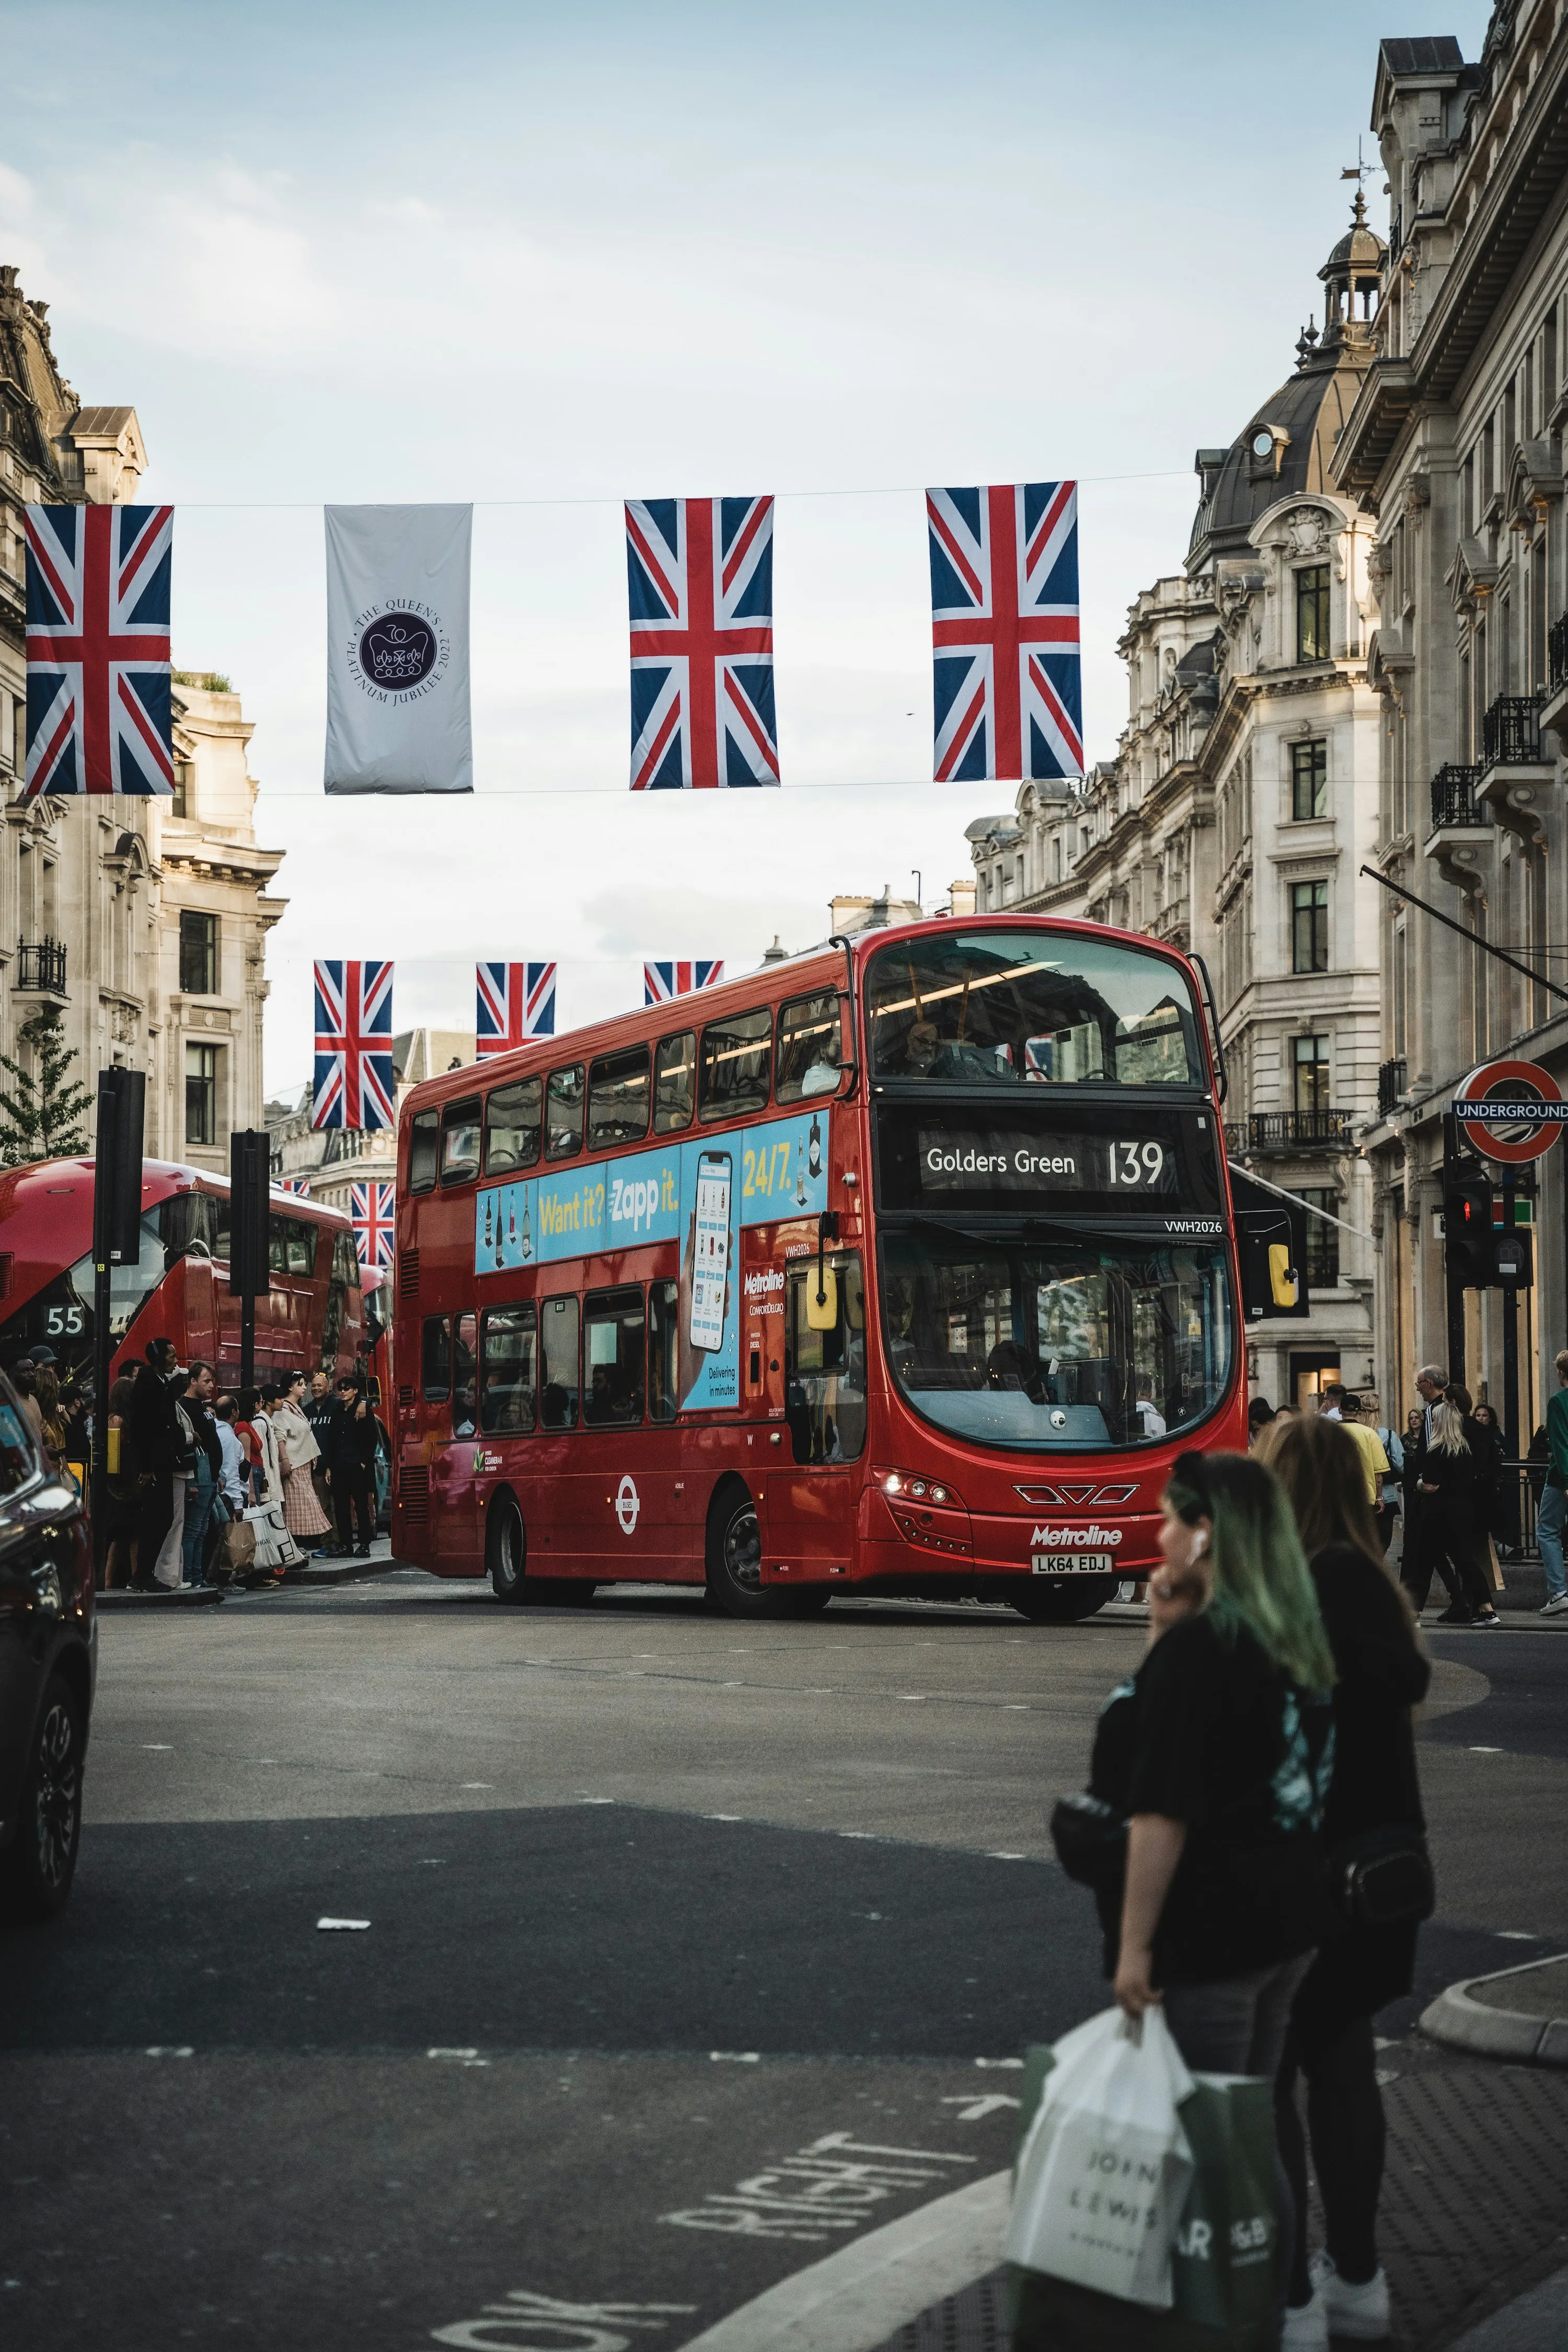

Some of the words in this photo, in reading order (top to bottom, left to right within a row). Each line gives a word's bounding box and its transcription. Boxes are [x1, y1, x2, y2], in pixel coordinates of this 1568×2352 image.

[355, 605, 382, 627] THE
[386, 599, 441, 626] QUEEN'S
[347, 641, 388, 702] PLATINUM
[392, 671, 443, 707] JUBILEE
[438, 638, 450, 668] 2022
[1457, 1104, 1568, 1118] UNDERGROUND
[927, 1148, 1007, 1172] Golders
[1014, 1150, 1075, 1173] Green
[1109, 1142, 1163, 1184] 139
[539, 1192, 581, 1237] Want
[583, 1183, 605, 1228] it?
[609, 1179, 659, 1232] Zapp
[662, 1168, 679, 1212] it.
[743, 1142, 791, 1197] 24/7.
[1164, 1220, 1223, 1233] VWH2026
[785, 1242, 810, 1258] VWH2026
[744, 1269, 784, 1296] Metroline
[47, 1307, 83, 1335] 55
[709, 1365, 735, 1381] Delivering
[709, 1385, 714, 1397] in
[715, 1386, 735, 1397] minutes
[309, 1416, 331, 1425] AWAII
[747, 1434, 753, 1446] W
[1030, 1525, 1123, 1546] Metroline
[1037, 1557, 1074, 1572] LK64
[1079, 1557, 1105, 1571] EDJ
[656, 2131, 978, 2242] RIGHT
